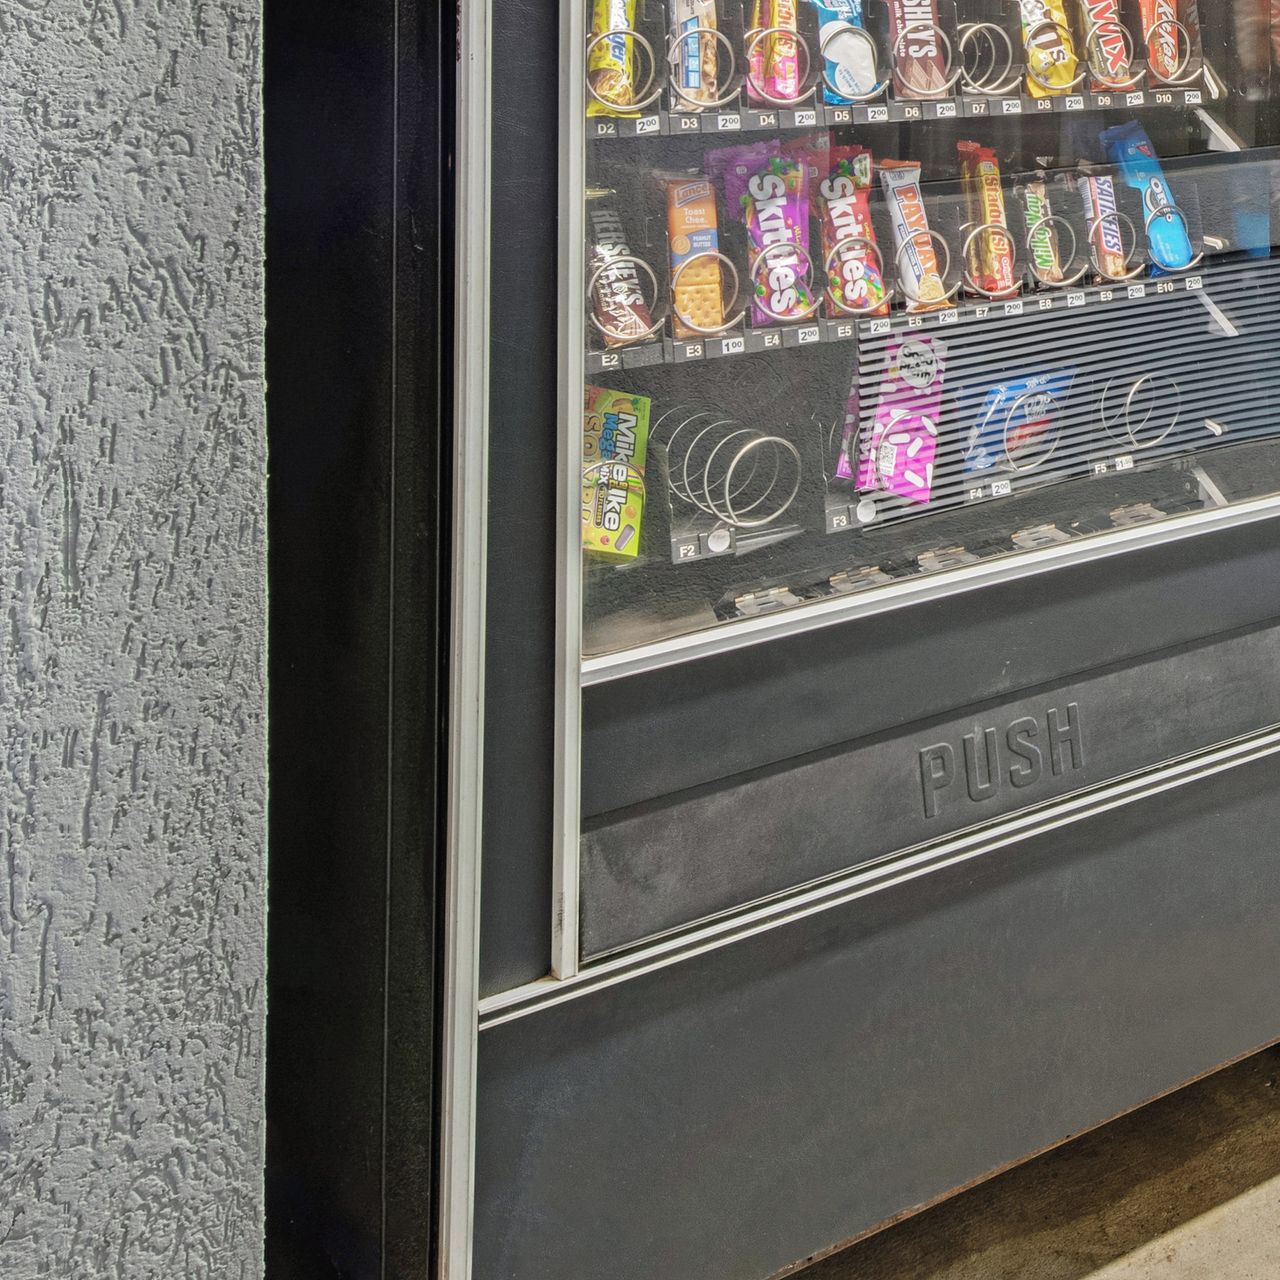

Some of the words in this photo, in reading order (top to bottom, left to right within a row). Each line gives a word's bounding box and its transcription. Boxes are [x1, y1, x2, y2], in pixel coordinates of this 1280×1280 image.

[893, 1, 903, 18] milk
[1038, 99, 1051, 109] D8
[1098, 96, 1111, 106] D9
[1156, 94, 1172, 104] D10
[905, 107, 919, 117] D6
[972, 103, 985, 113] D7
[760, 115, 776, 125] D4
[834, 110, 849, 120] D5
[682, 118, 698, 128] D3
[598, 125, 615, 135] D2
[677, 184, 708, 201] Lance
[683, 207, 705, 216] Toast
[749, 174, 797, 313] Skittles
[820, 176, 868, 301] Skittles
[1031, 226, 1055, 269] Milky
[1157, 283, 1173, 293] E10
[1101, 291, 1113, 300] E9
[1039, 300, 1051, 309] E8
[976, 308, 989, 317] E7
[909, 317, 922, 326] E6
[838, 326, 852, 336] E5
[765, 335, 780, 346] E4
[686, 347, 702, 357] E3
[601, 354, 618, 366] E2
[600, 413, 619, 461] Mega
[1094, 463, 1107, 474] F5
[969, 488, 983, 498] F4
[603, 488, 628, 531] Ike
[833, 516, 847, 526] F3
[679, 546, 695, 556] F2
[919, 702, 1085, 819] PUSH
